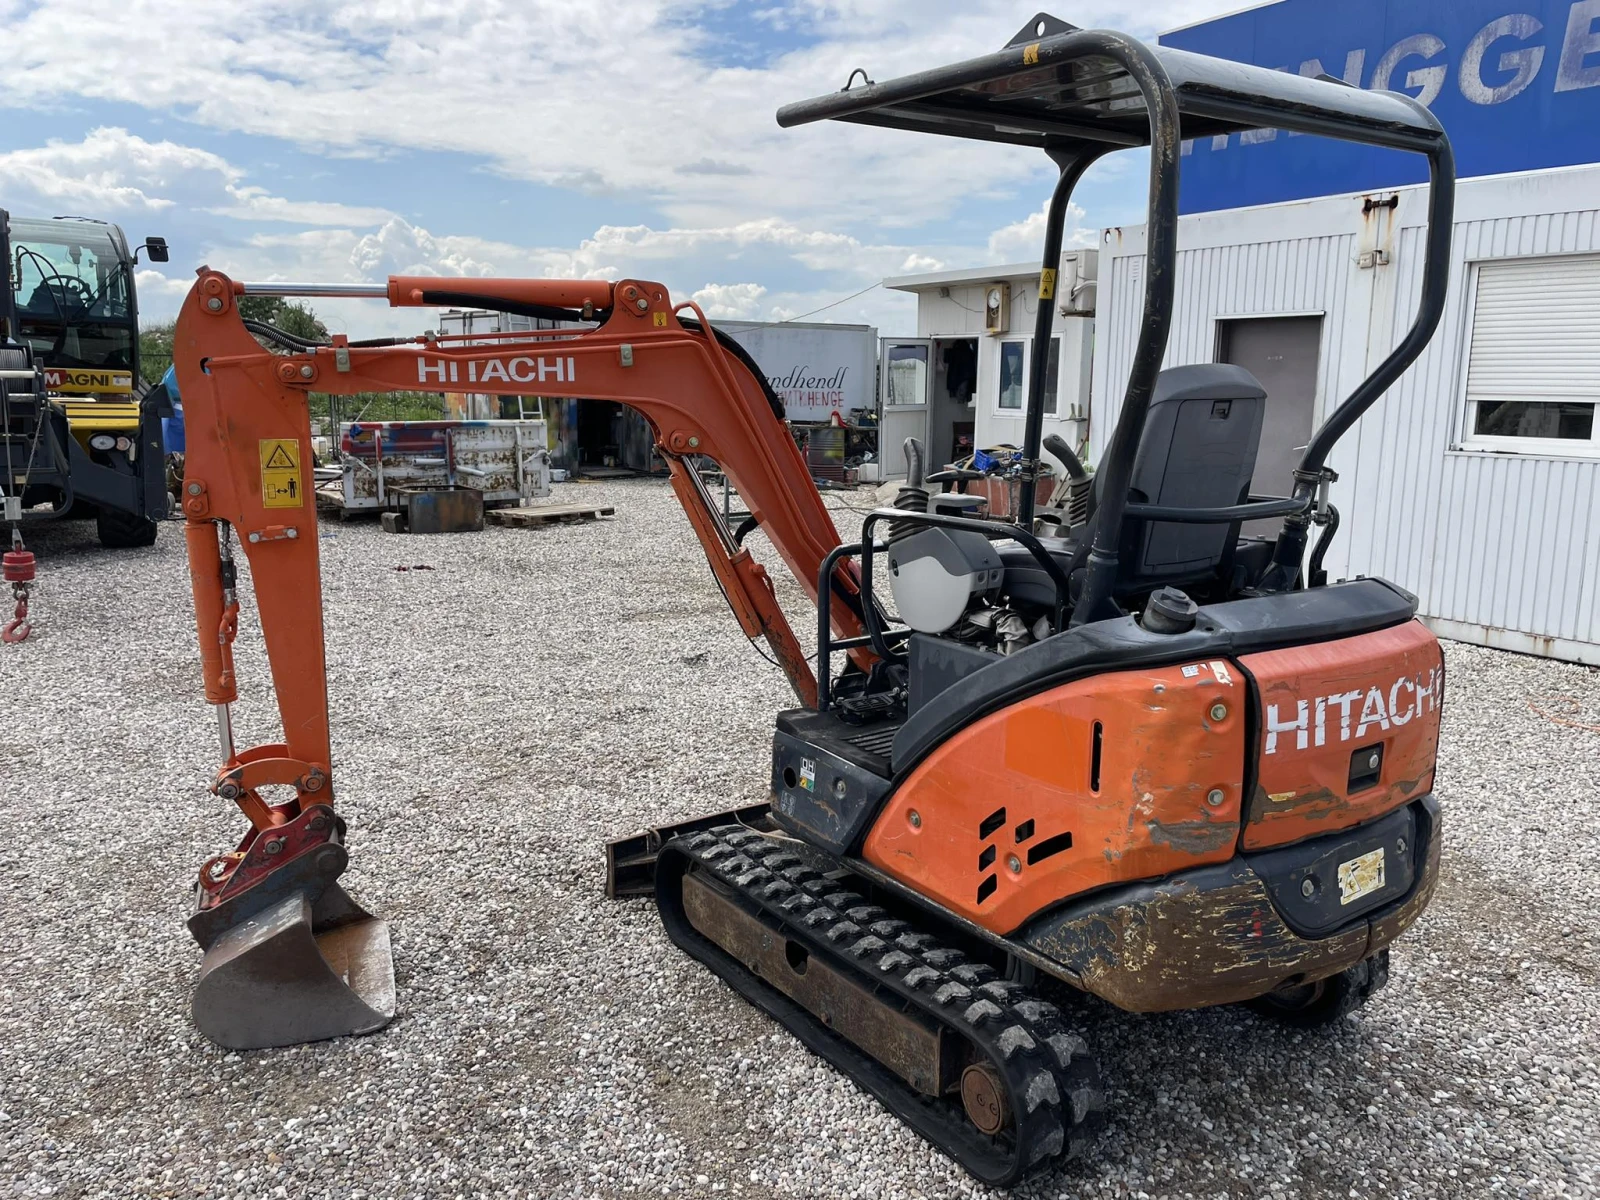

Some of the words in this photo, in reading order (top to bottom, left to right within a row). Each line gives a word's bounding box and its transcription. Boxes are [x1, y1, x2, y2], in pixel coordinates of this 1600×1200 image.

[44, 372, 109, 387] MAGNI
[417, 356, 575, 383] HITACHI
[765, 365, 850, 389] ndhendl
